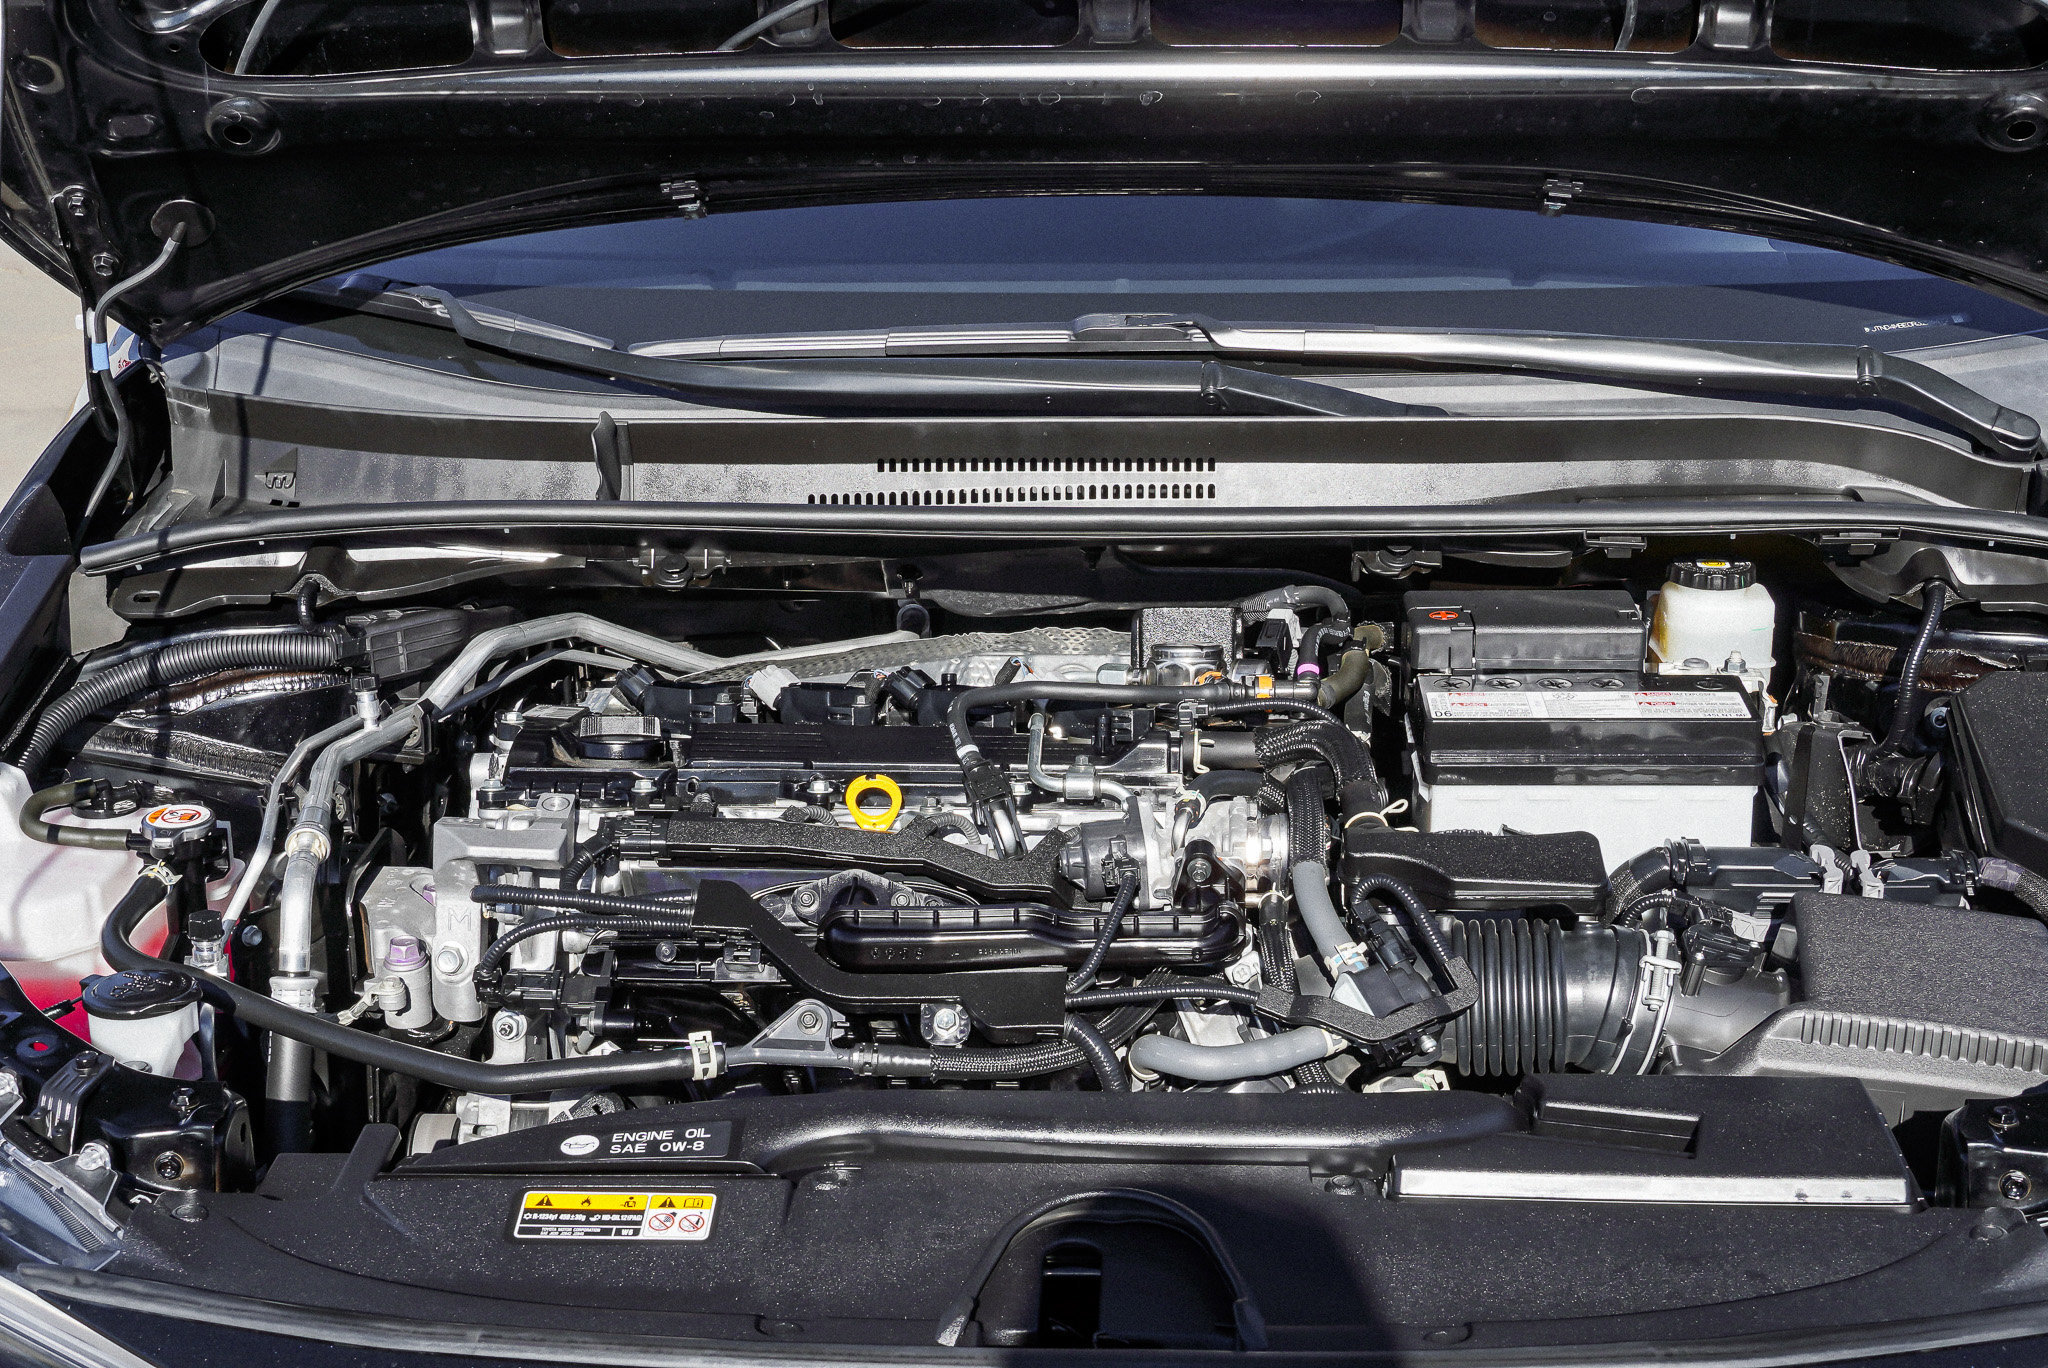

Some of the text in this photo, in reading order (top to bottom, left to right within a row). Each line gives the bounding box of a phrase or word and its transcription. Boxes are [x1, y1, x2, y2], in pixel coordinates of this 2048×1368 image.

[612, 1128, 711, 1143] ENGINE OIL
[610, 1143, 647, 1154] SAE
